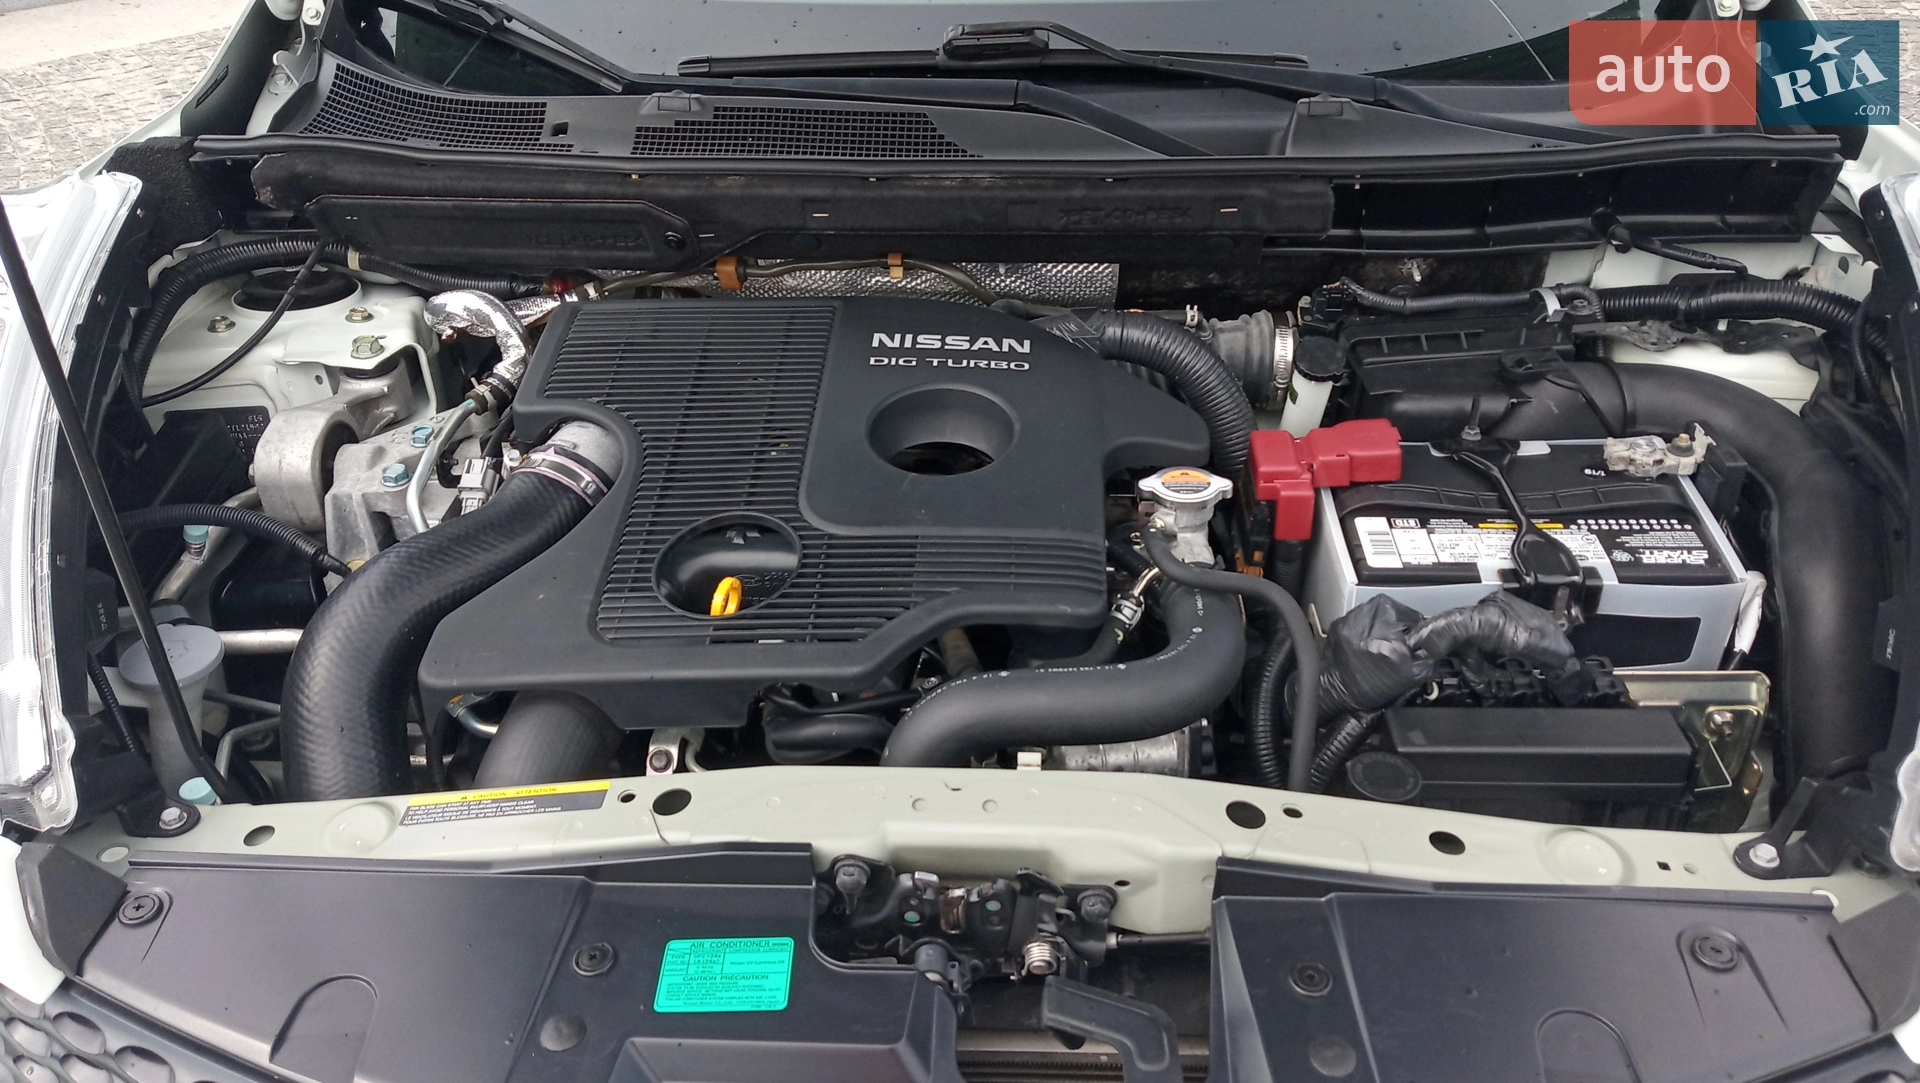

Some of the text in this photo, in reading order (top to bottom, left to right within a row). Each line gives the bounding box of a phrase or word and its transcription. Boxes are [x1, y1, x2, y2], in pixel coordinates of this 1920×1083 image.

[871, 332, 1031, 354] NISSAN
[869, 356, 1030, 371] DIG TURBO
[1641, 549, 1709, 559] START
[1642, 556, 1705, 565] SUPER
[690, 941, 705, 949] AIR
[709, 940, 771, 949] CONDITIONER
[682, 974, 717, 982] CAUTION
